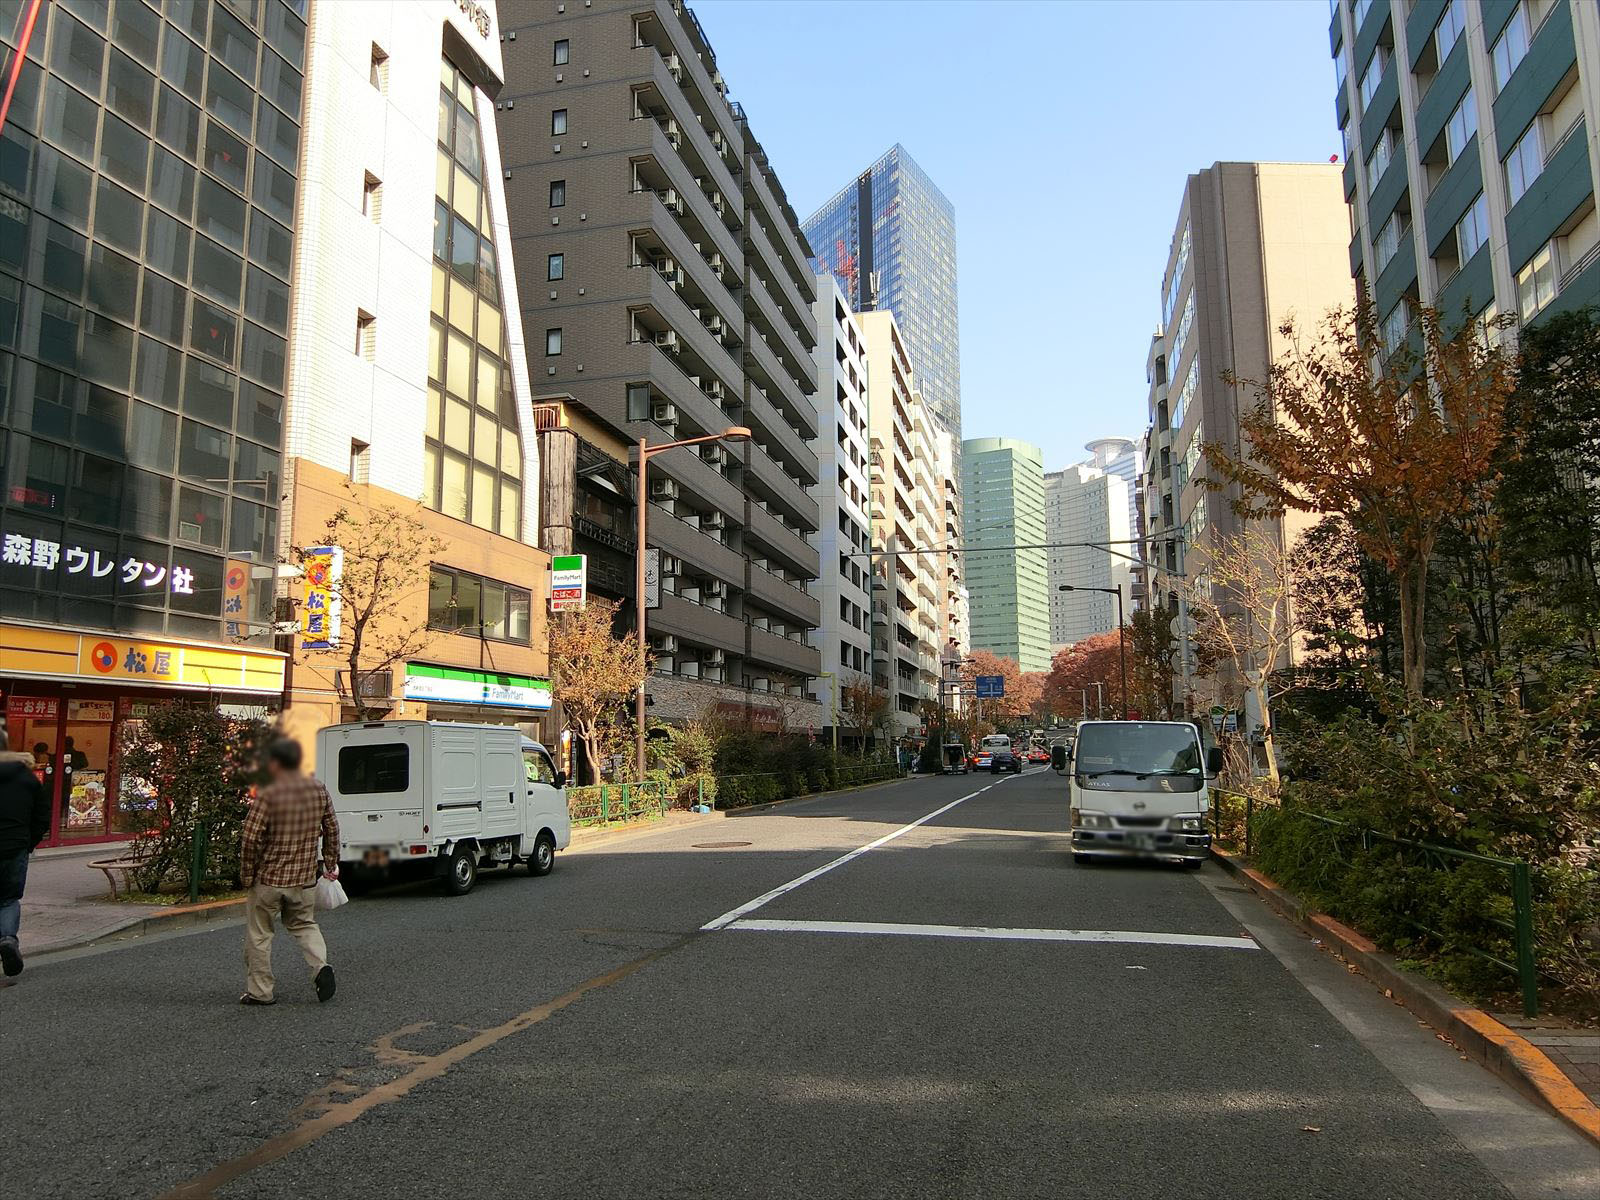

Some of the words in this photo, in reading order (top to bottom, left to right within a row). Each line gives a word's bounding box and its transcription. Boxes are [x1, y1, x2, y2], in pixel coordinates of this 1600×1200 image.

[2, 534, 194, 594] 森野ウレタン社
[307, 591, 325, 633] 松屋
[123, 647, 172, 675] 松屋
[24, 700, 57, 714] お弁当
[492, 688, 524, 701] FamilyMart
